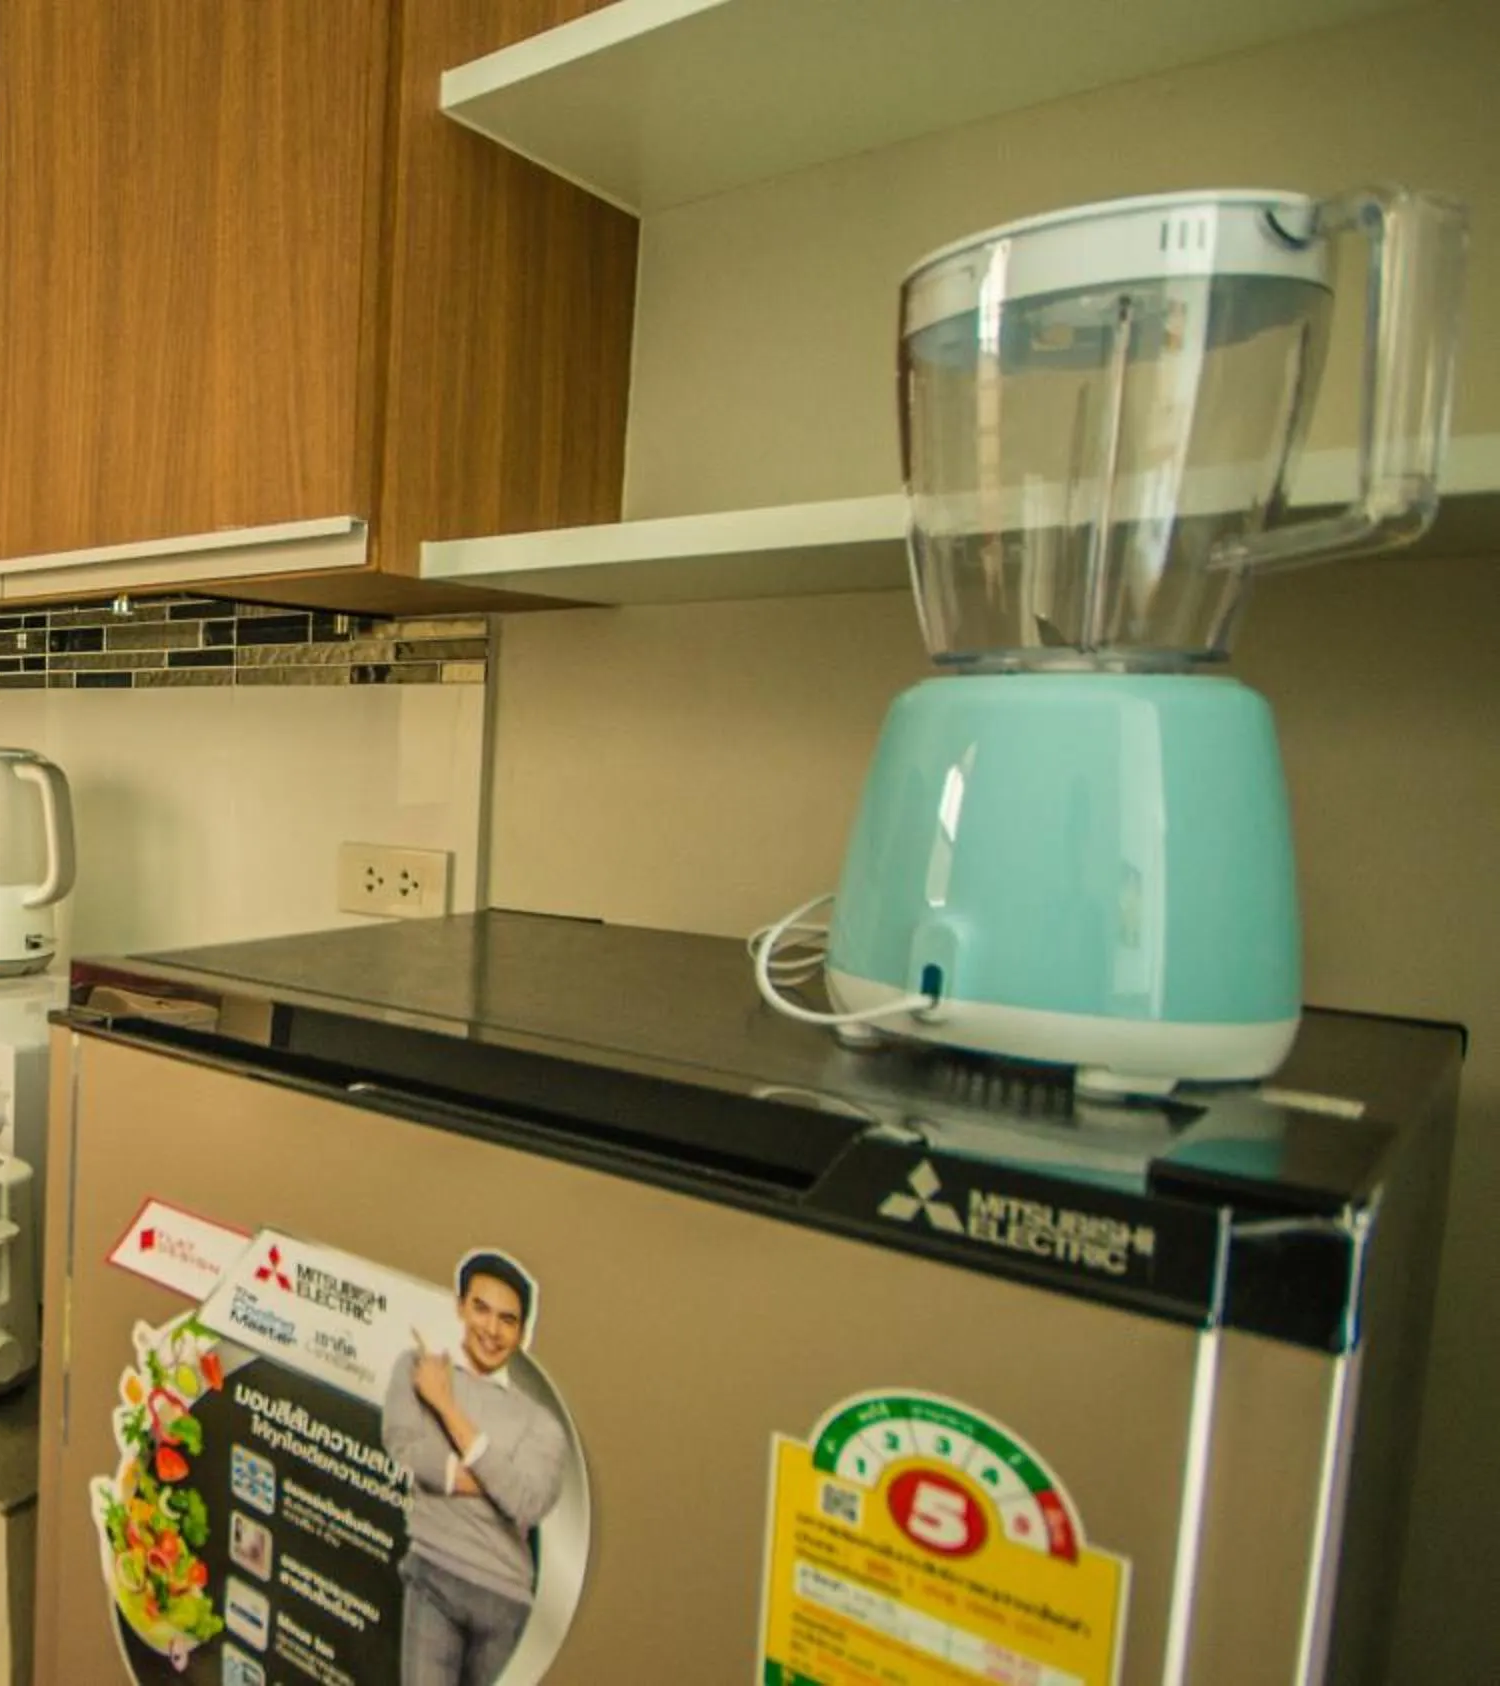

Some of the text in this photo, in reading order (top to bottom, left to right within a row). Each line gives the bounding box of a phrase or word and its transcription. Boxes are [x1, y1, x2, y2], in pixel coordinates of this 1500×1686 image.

[968, 1188, 1155, 1256] MITSUBISHI
[968, 1216, 1128, 1275] ELECTRIC
[296, 1263, 387, 1312] MITSUBISHI
[296, 1281, 373, 1326] ELECTRIC
[229, 1308, 298, 1346] Master
[884, 1431, 900, 1452] 2
[936, 1436, 953, 1457] 3
[906, 1479, 970, 1551] 5
